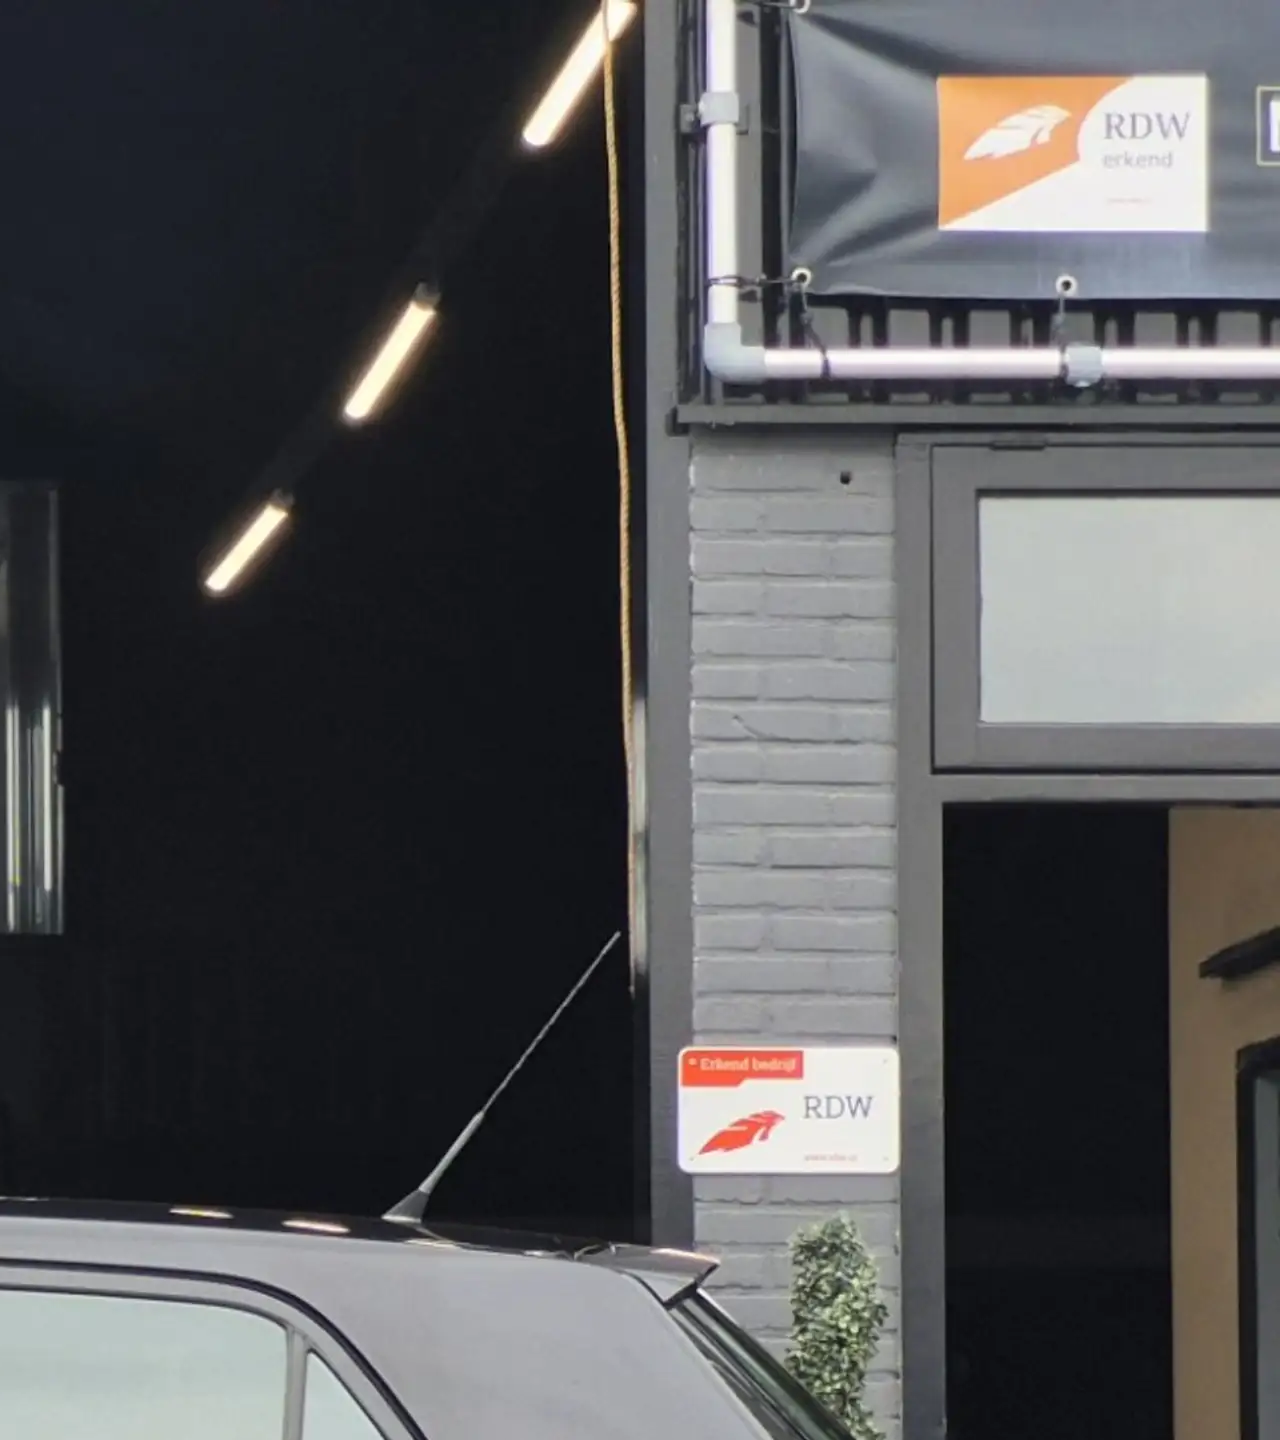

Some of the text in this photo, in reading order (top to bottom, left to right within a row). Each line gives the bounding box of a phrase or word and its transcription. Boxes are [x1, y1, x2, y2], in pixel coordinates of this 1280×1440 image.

[1104, 112, 1191, 140] RDW
[1103, 151, 1173, 168] erkend
[700, 1056, 796, 1073] Erkend bedrijf
[803, 1096, 873, 1119] RDW
